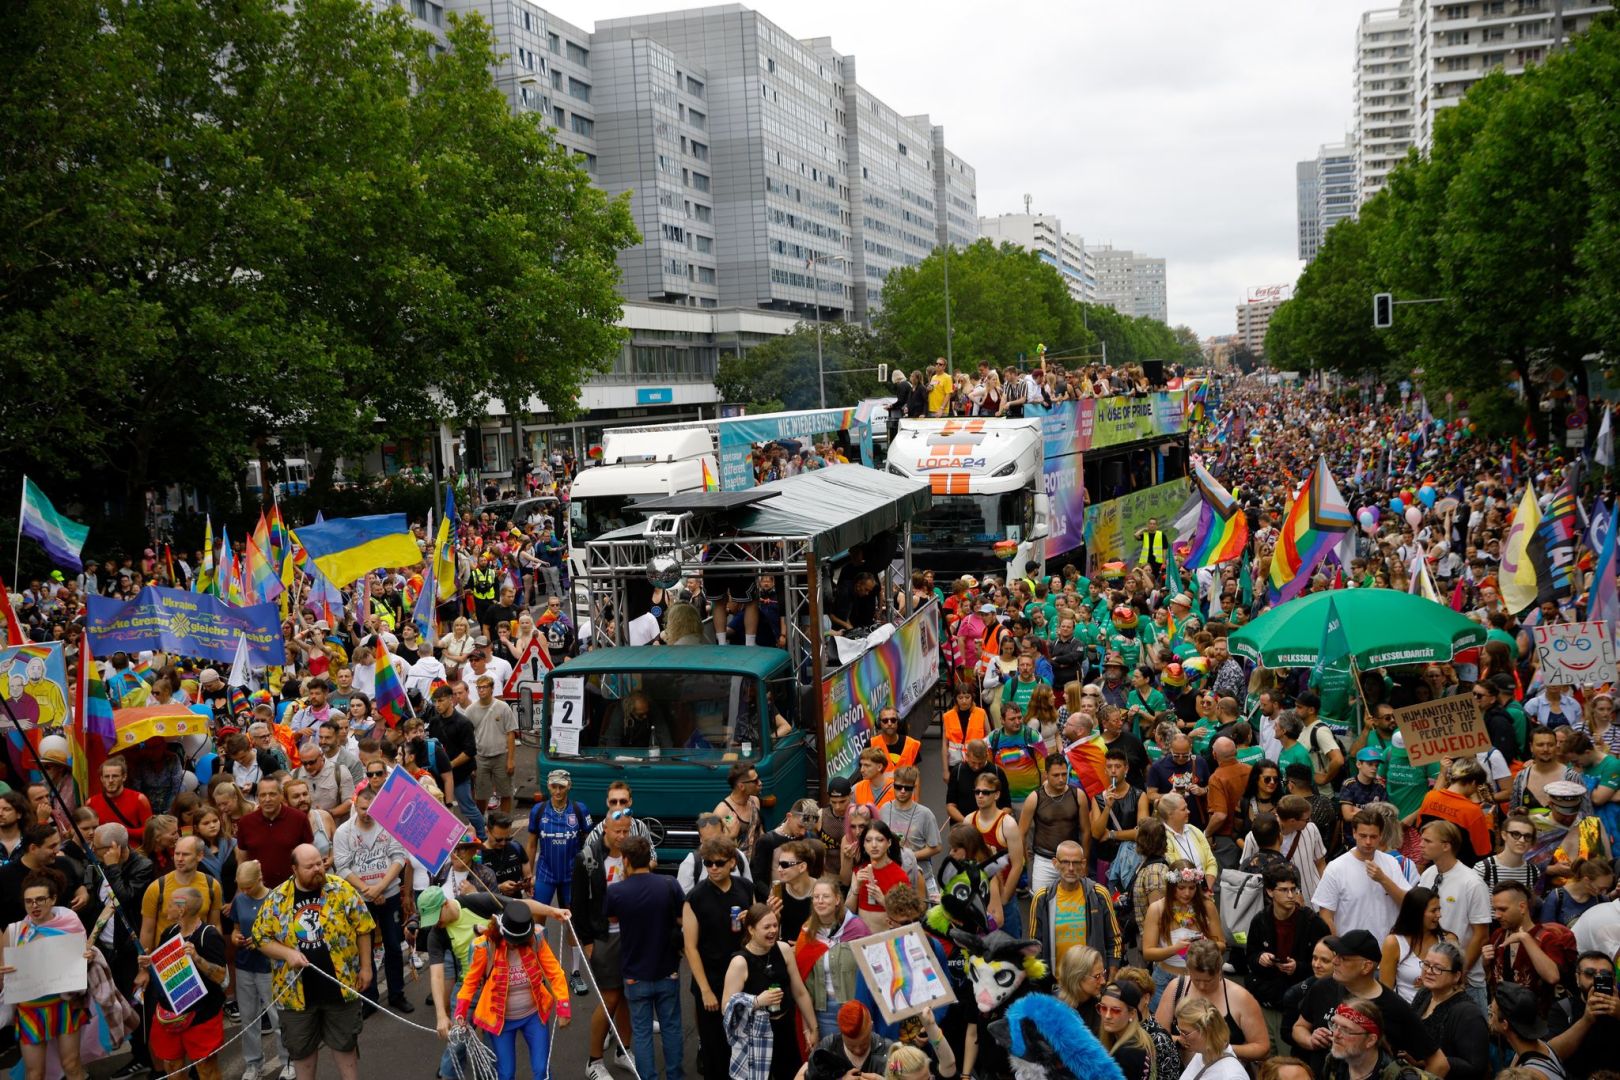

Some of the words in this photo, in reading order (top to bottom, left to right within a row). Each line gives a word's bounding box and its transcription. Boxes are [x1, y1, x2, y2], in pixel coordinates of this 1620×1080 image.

[1132, 403, 1152, 417] PRIDE
[917, 457, 986, 469] LOCA24
[1044, 468, 1076, 494] ROTECT
[562, 700, 573, 724] 2
[1401, 698, 1474, 724] HUMANITARIAN
[1411, 718, 1430, 732] AID
[1433, 713, 1456, 727] FOR
[1457, 709, 1476, 722] THE
[1419, 725, 1455, 740] PEOPLE
[1460, 721, 1474, 733] OF
[1409, 731, 1489, 761] SUWEIDA
